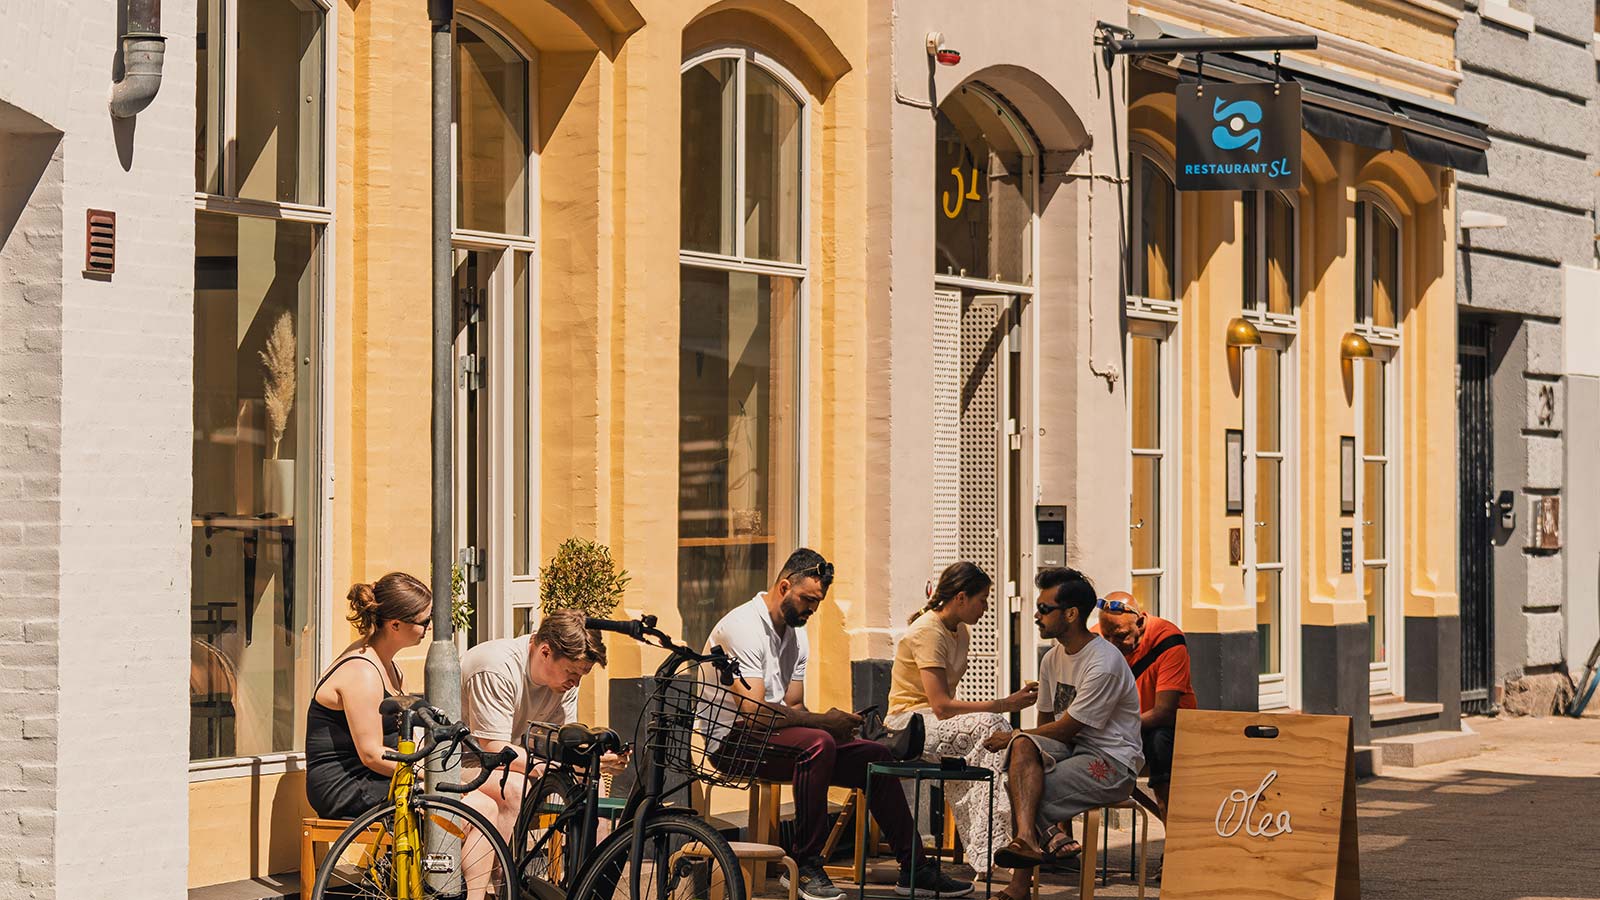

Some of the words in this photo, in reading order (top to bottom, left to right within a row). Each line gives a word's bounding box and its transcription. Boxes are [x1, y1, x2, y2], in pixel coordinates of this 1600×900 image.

[1185, 163, 1268, 175] RESTAURANT
[1268, 158, 1291, 178] SL
[1215, 769, 1293, 838] Olea
